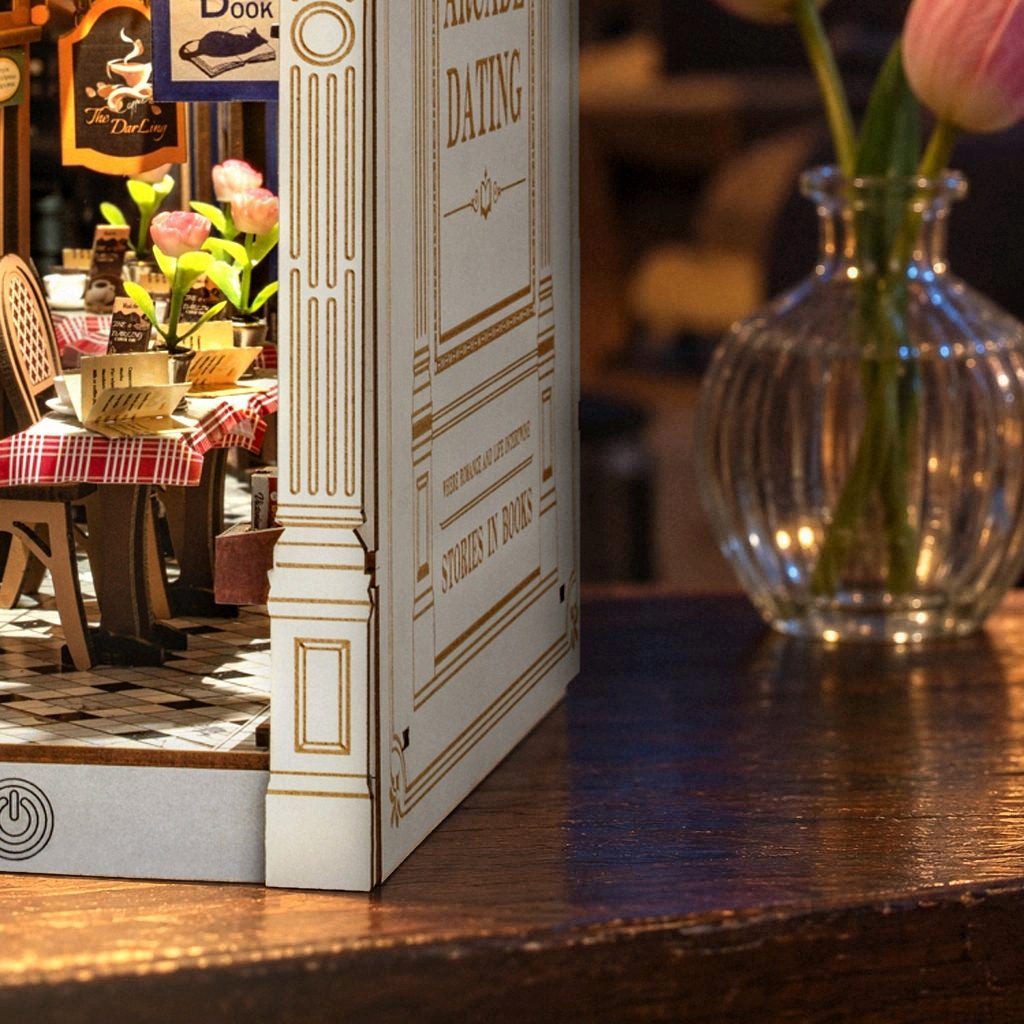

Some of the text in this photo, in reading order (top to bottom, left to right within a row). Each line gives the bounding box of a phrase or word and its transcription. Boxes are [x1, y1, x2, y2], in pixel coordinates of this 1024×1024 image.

[84, 105, 110, 125] The
[446, 48, 522, 149] DATING
[483, 447, 492, 470] AND
[493, 439, 504, 462] LIFE
[441, 487, 533, 594] STORIES IN BOOKS
